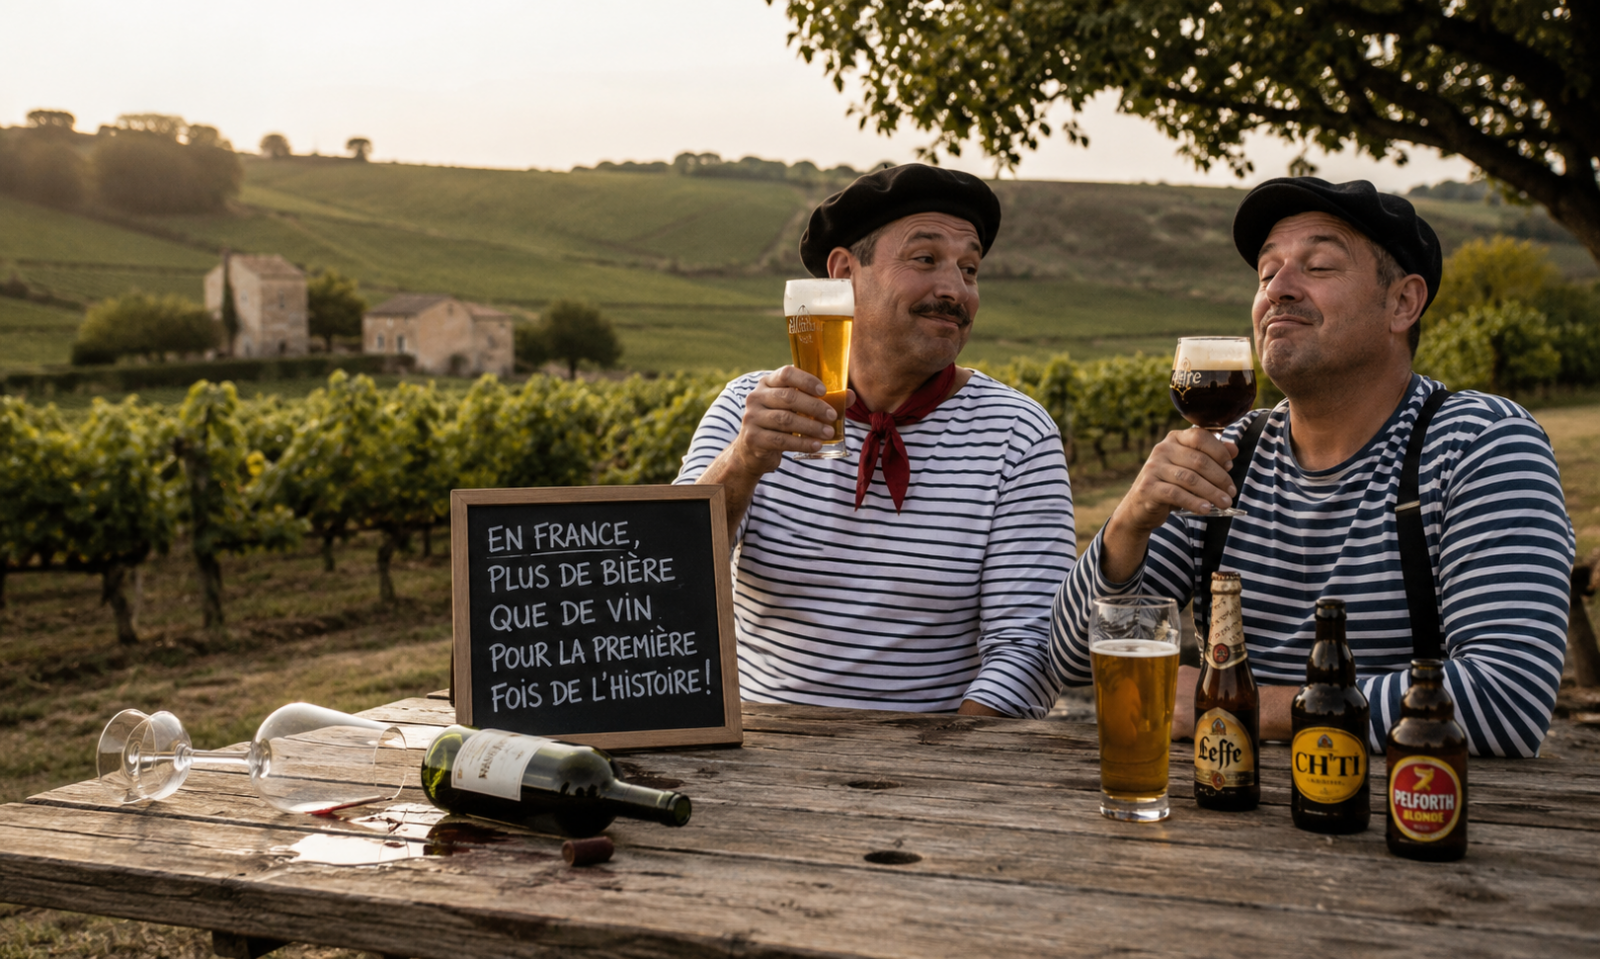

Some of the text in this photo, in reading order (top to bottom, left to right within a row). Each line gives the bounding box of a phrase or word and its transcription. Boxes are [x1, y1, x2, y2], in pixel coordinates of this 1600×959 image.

[488, 521, 640, 552] EN FRANCE,
[488, 552, 676, 593] PLUS DE BIÈRE
[490, 592, 652, 632] QUE DE VIN
[489, 625, 698, 672] POUR LA PREMIÈRE
[491, 679, 542, 712] FOIS
[550, 679, 582, 706] DE
[1198, 736, 1242, 770] Leffe
[1394, 788, 1455, 810] PELFORTH
[1402, 809, 1444, 823] BLONDE
